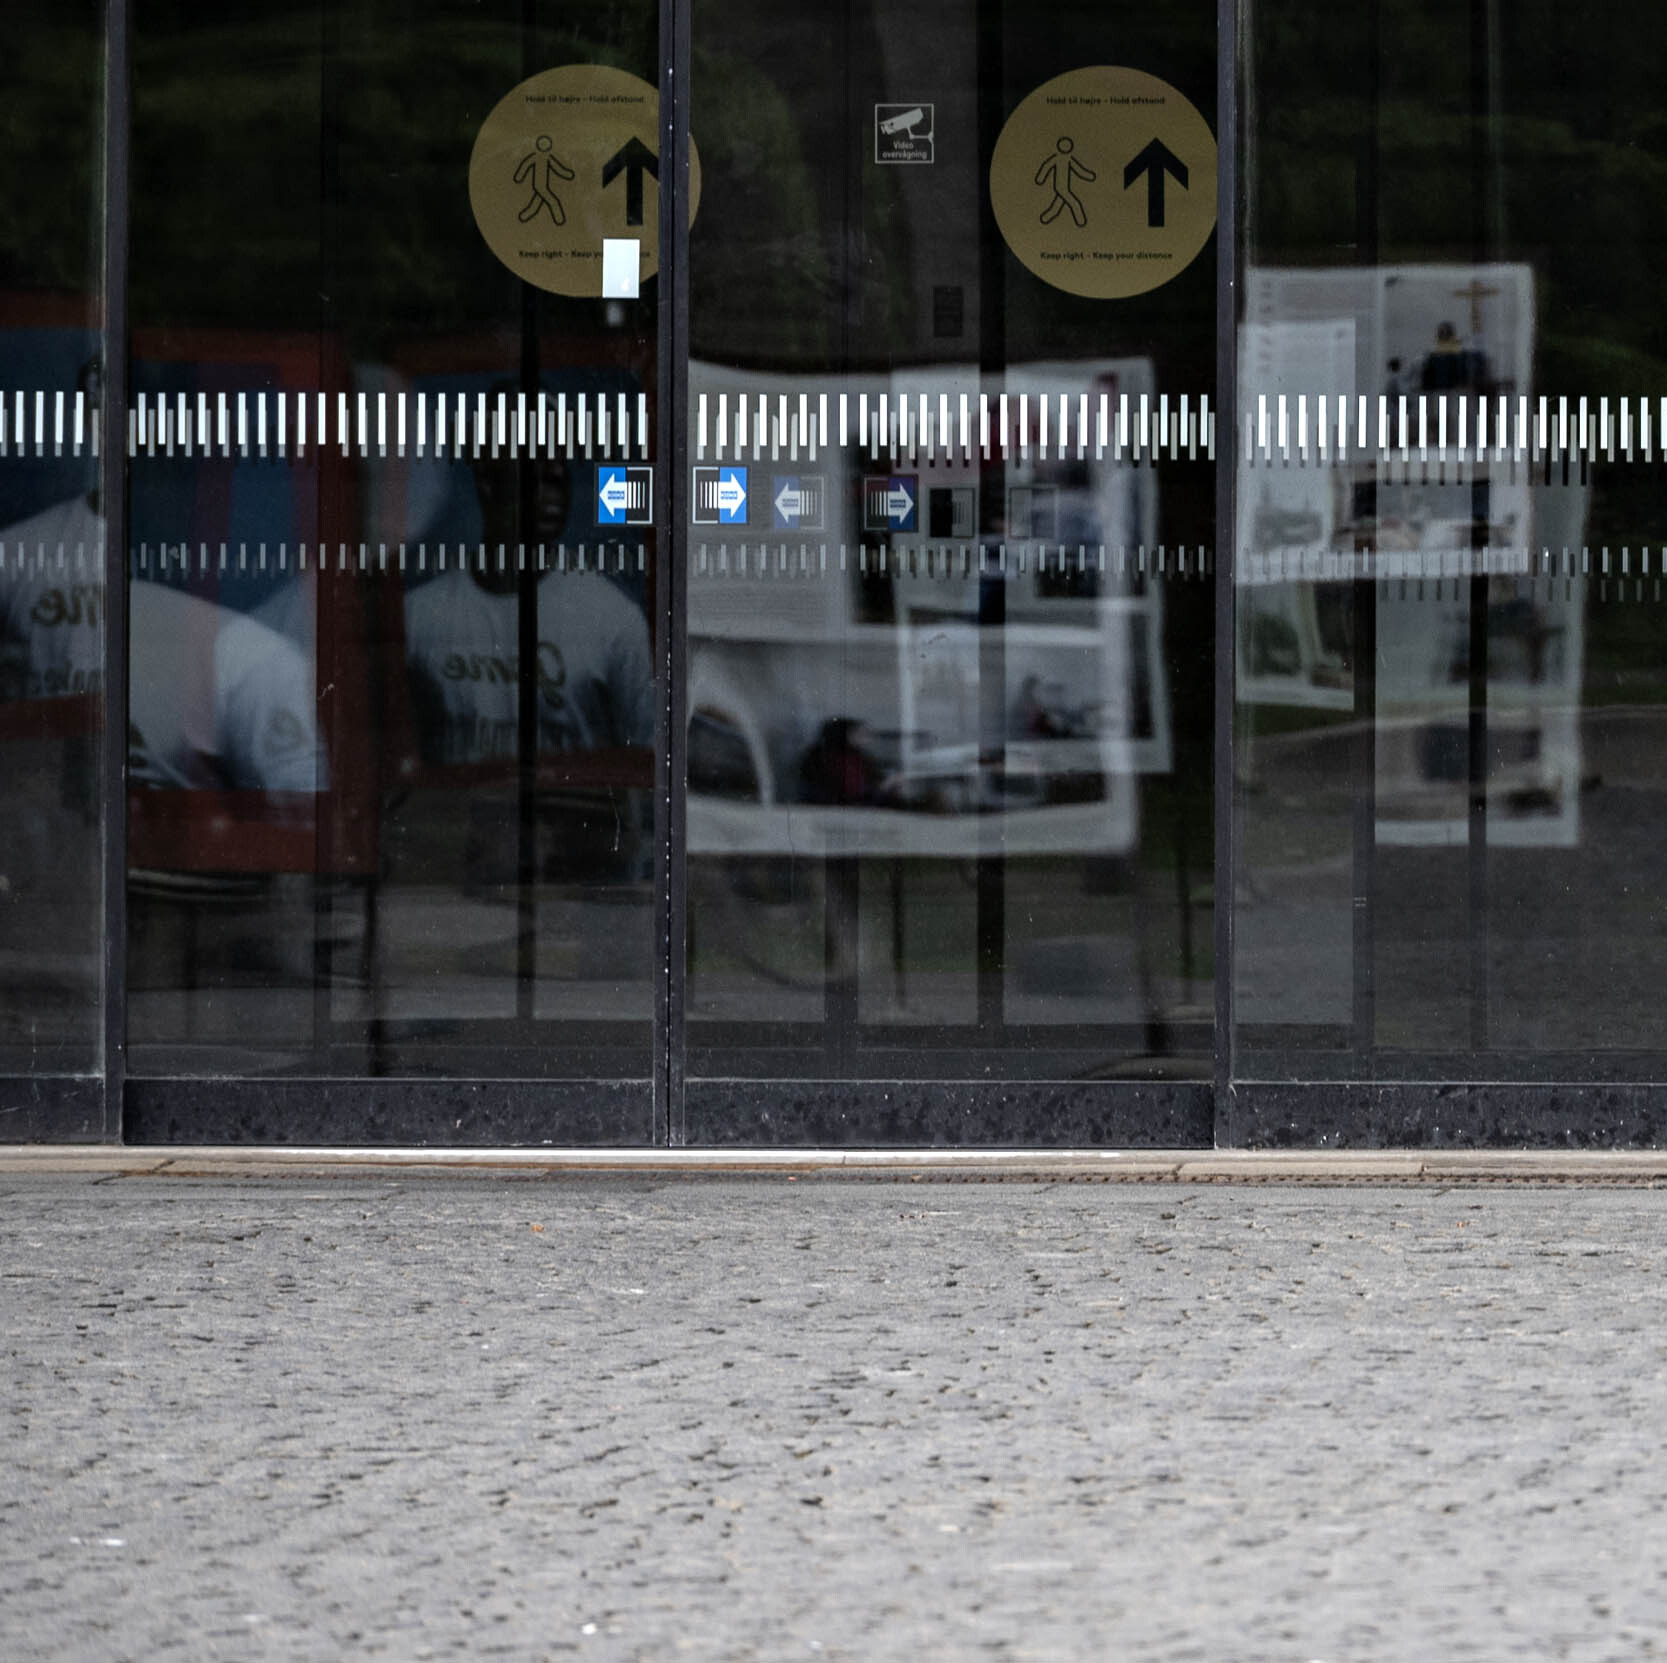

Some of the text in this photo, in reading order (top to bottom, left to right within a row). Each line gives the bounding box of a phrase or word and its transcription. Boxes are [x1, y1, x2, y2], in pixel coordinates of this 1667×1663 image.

[1046, 96, 1066, 105] Hold
[518, 251, 541, 260] Keep
[1040, 252, 1061, 261] Keep
[1062, 252, 1084, 261] right
[1092, 252, 1114, 261] Keep
[1115, 252, 1135, 262] your
[1136, 252, 1173, 261] distance
